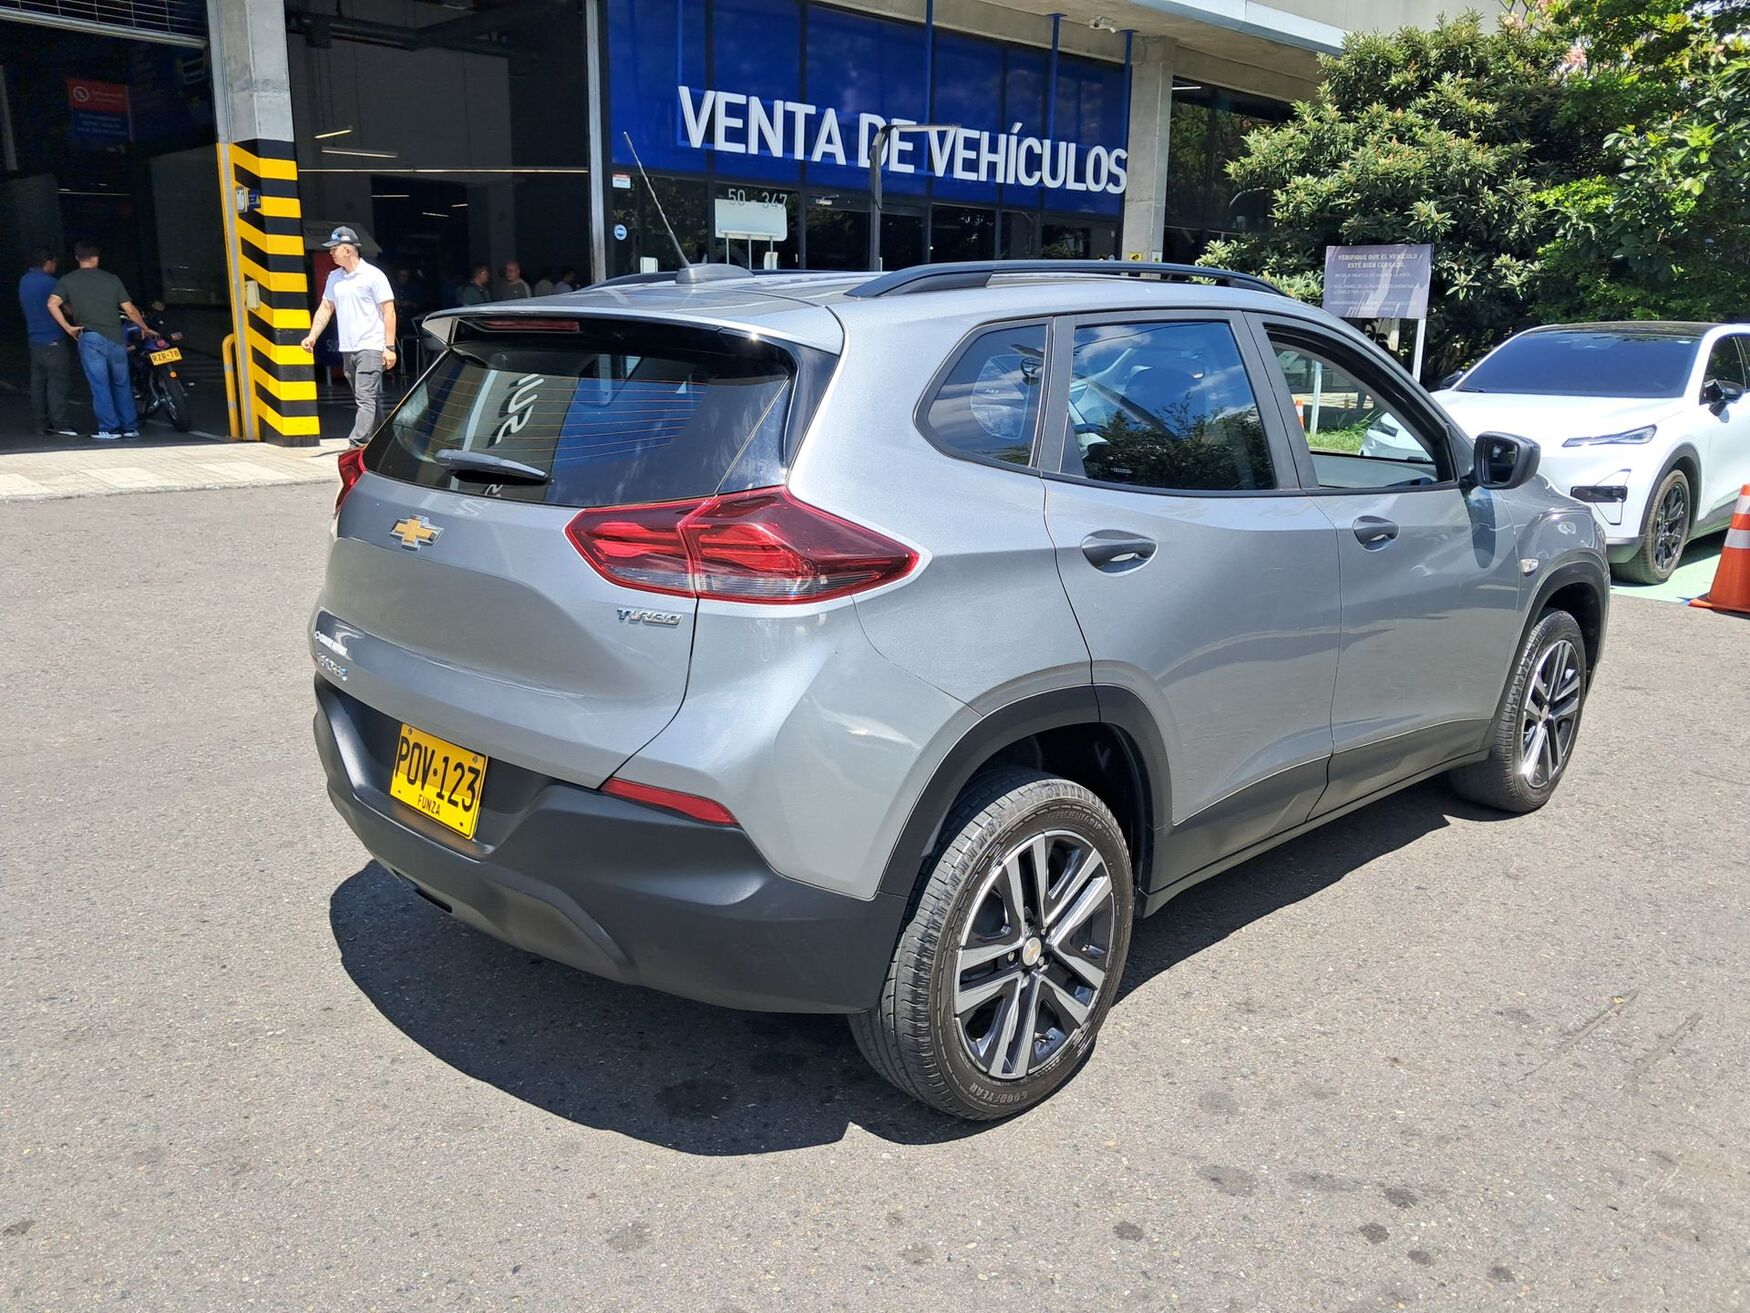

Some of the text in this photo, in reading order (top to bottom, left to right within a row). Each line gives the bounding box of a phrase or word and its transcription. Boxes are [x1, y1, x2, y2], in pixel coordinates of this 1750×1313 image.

[678, 85, 1128, 195] VENTA DE VEHÍCULOS
[728, 188, 746, 206] 50
[761, 191, 788, 210] 347
[417, 794, 441, 816] FUNZA
